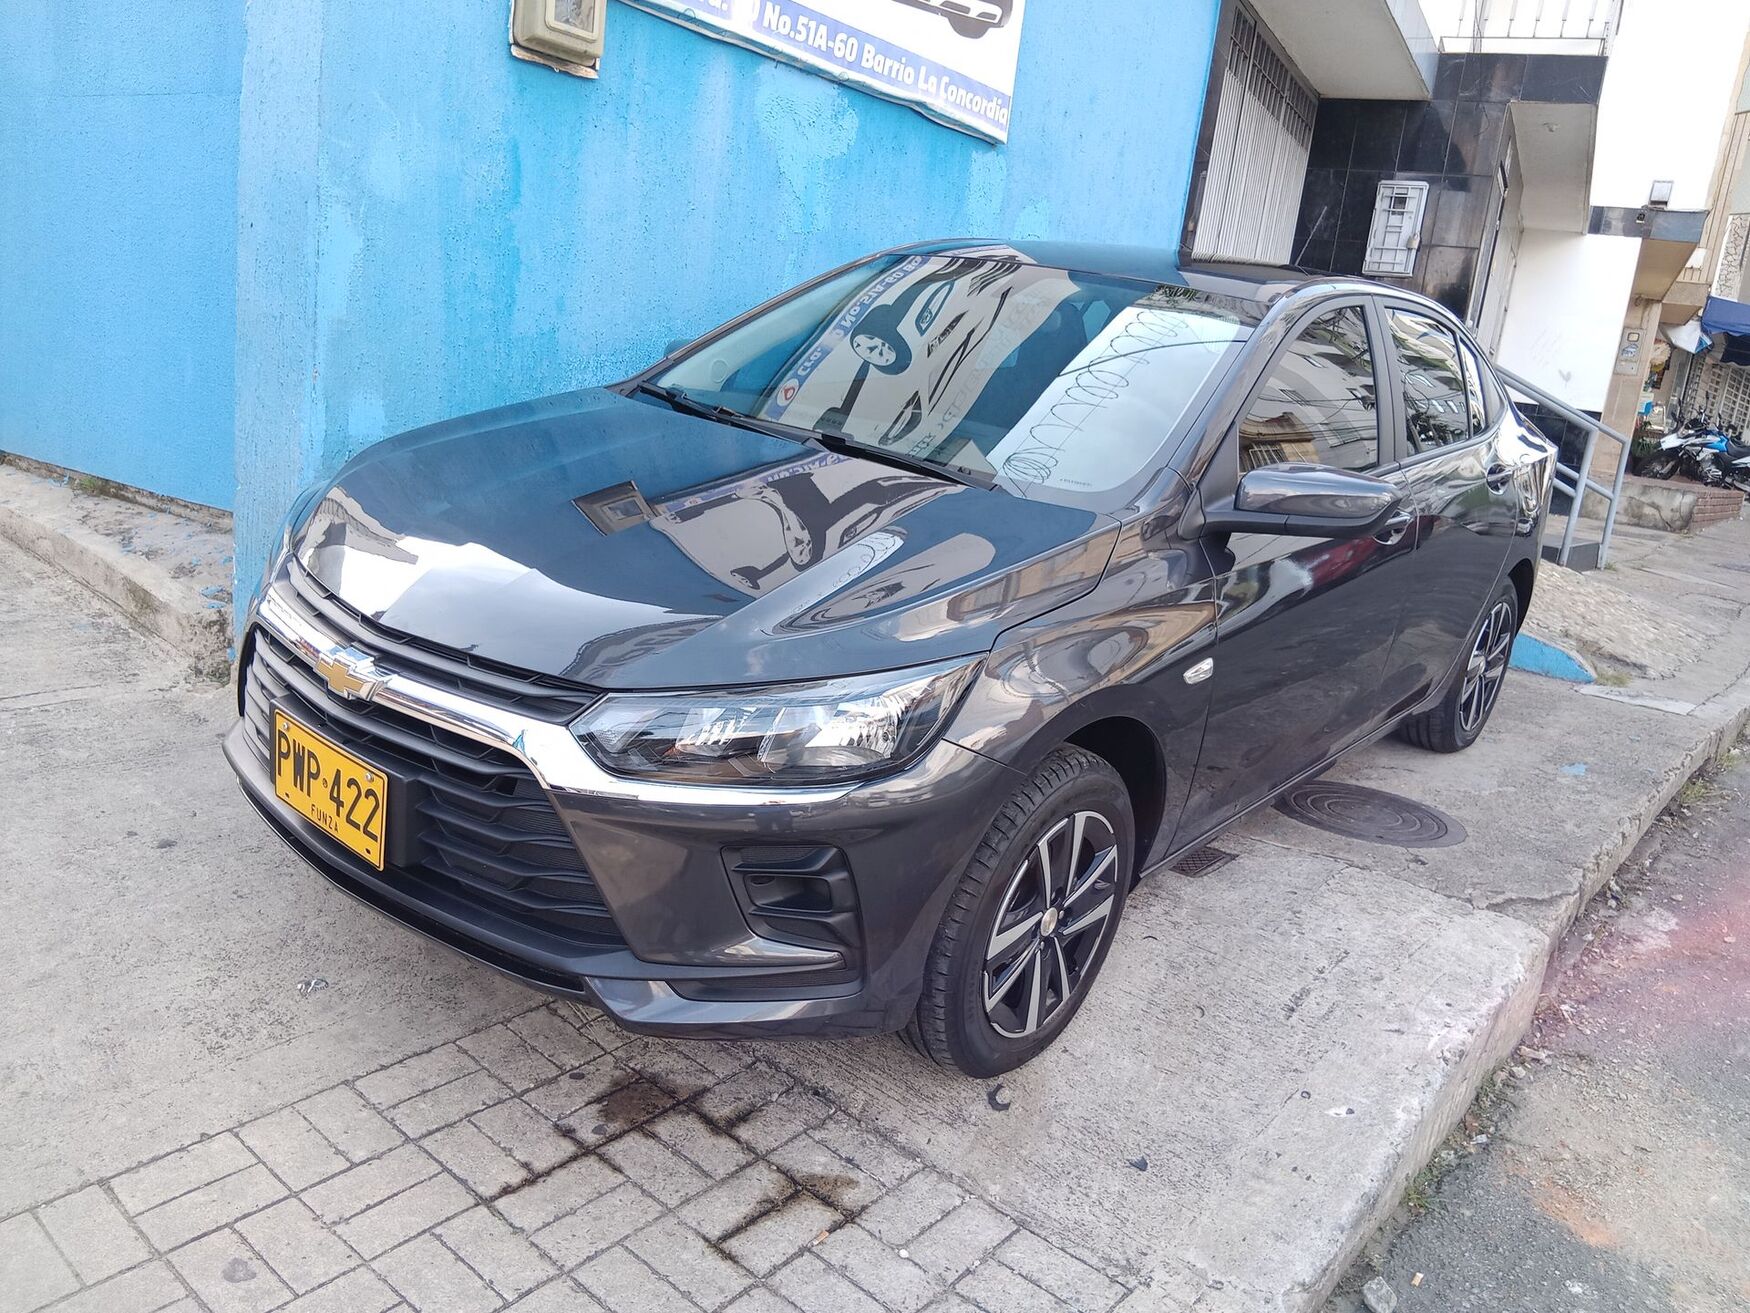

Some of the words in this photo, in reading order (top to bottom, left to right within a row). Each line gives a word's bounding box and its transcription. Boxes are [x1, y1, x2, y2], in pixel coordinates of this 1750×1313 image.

[762, 5, 858, 63] No.51A-60
[861, 43, 915, 85] Barrio
[917, 65, 937, 93] La
[939, 72, 1008, 124] Concordia
[311, 803, 339, 833] FUNZA
